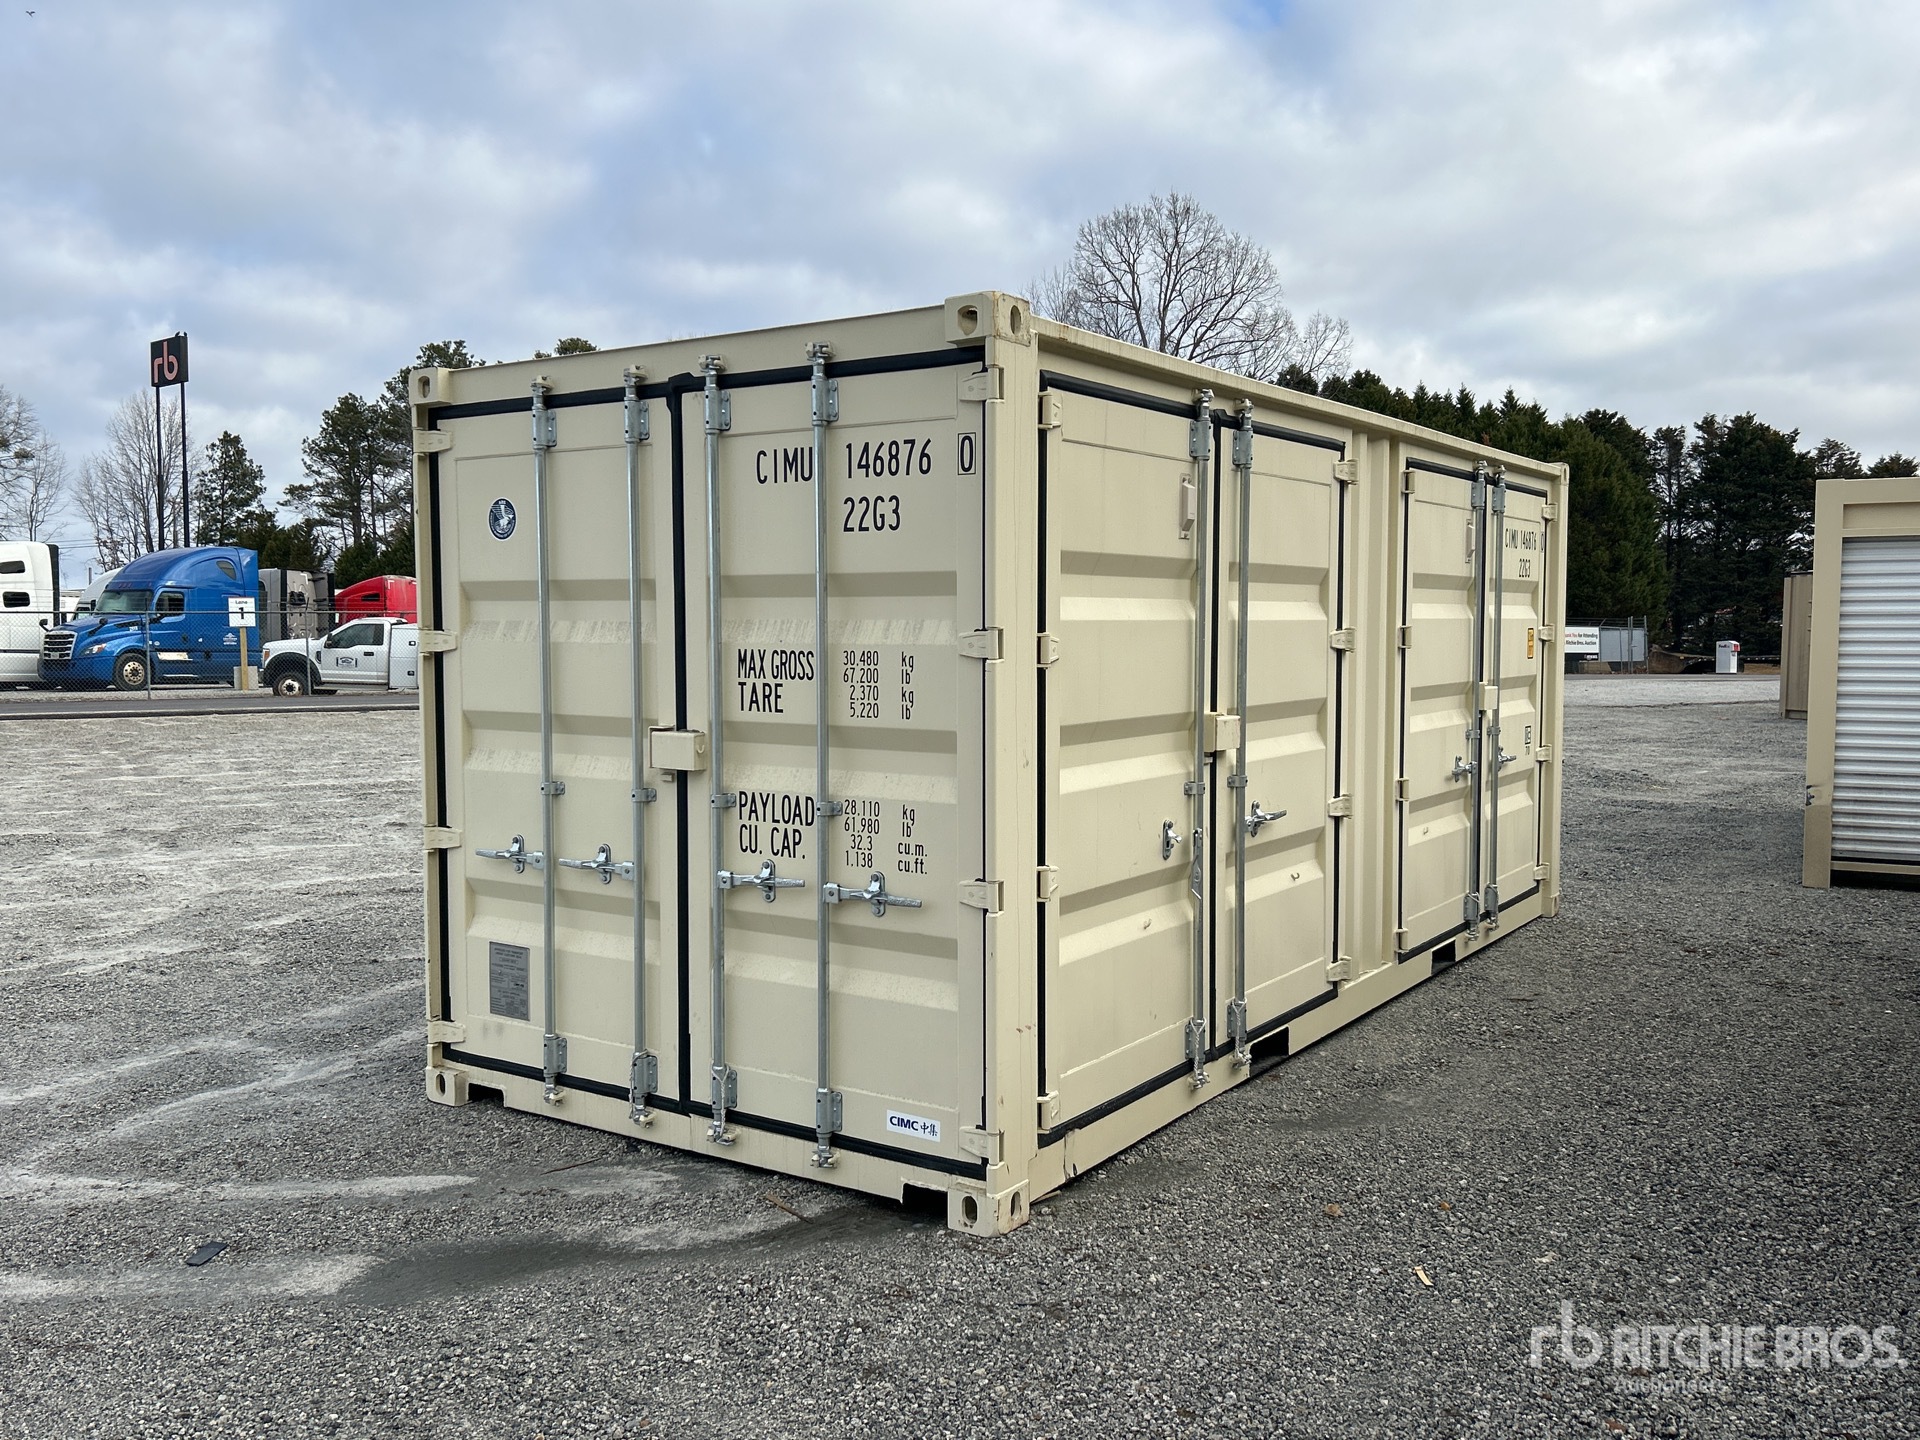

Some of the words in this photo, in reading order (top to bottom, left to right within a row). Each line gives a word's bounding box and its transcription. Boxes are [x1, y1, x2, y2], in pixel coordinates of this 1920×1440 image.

[153, 341, 179, 384] rb
[756, 446, 814, 484] CIMU
[846, 438, 932, 479] 146876
[959, 434, 974, 473] 0
[843, 495, 901, 532] 22G3
[1505, 528, 1519, 549] CIMU
[1520, 530, 1537, 551] 146876
[238, 607, 245, 619] 1
[737, 649, 767, 679] MAX
[771, 650, 815, 681] GROSS
[843, 650, 879, 667] 30.480
[901, 652, 914, 672] kg
[843, 668, 879, 684] 67.200
[901, 668, 911, 685] lb
[738, 682, 784, 713] TARE
[849, 685, 879, 701] 2.370
[901, 687, 914, 707] kg
[849, 702, 879, 719] 5.220
[901, 704, 911, 720] lb
[738, 791, 815, 827] PAYLOAD
[844, 800, 880, 817] 28.110
[902, 805, 915, 826] kg
[844, 817, 880, 834] 61.980
[902, 822, 912, 838] lb
[739, 824, 763, 855] CU.
[770, 828, 806, 860] CAP.
[850, 834, 873, 851] 32.3
[897, 841, 928, 858] cu.m.
[845, 851, 873, 868] 1.138
[897, 858, 928, 875] cu.ft.
[889, 1116, 919, 1131] CIMC
